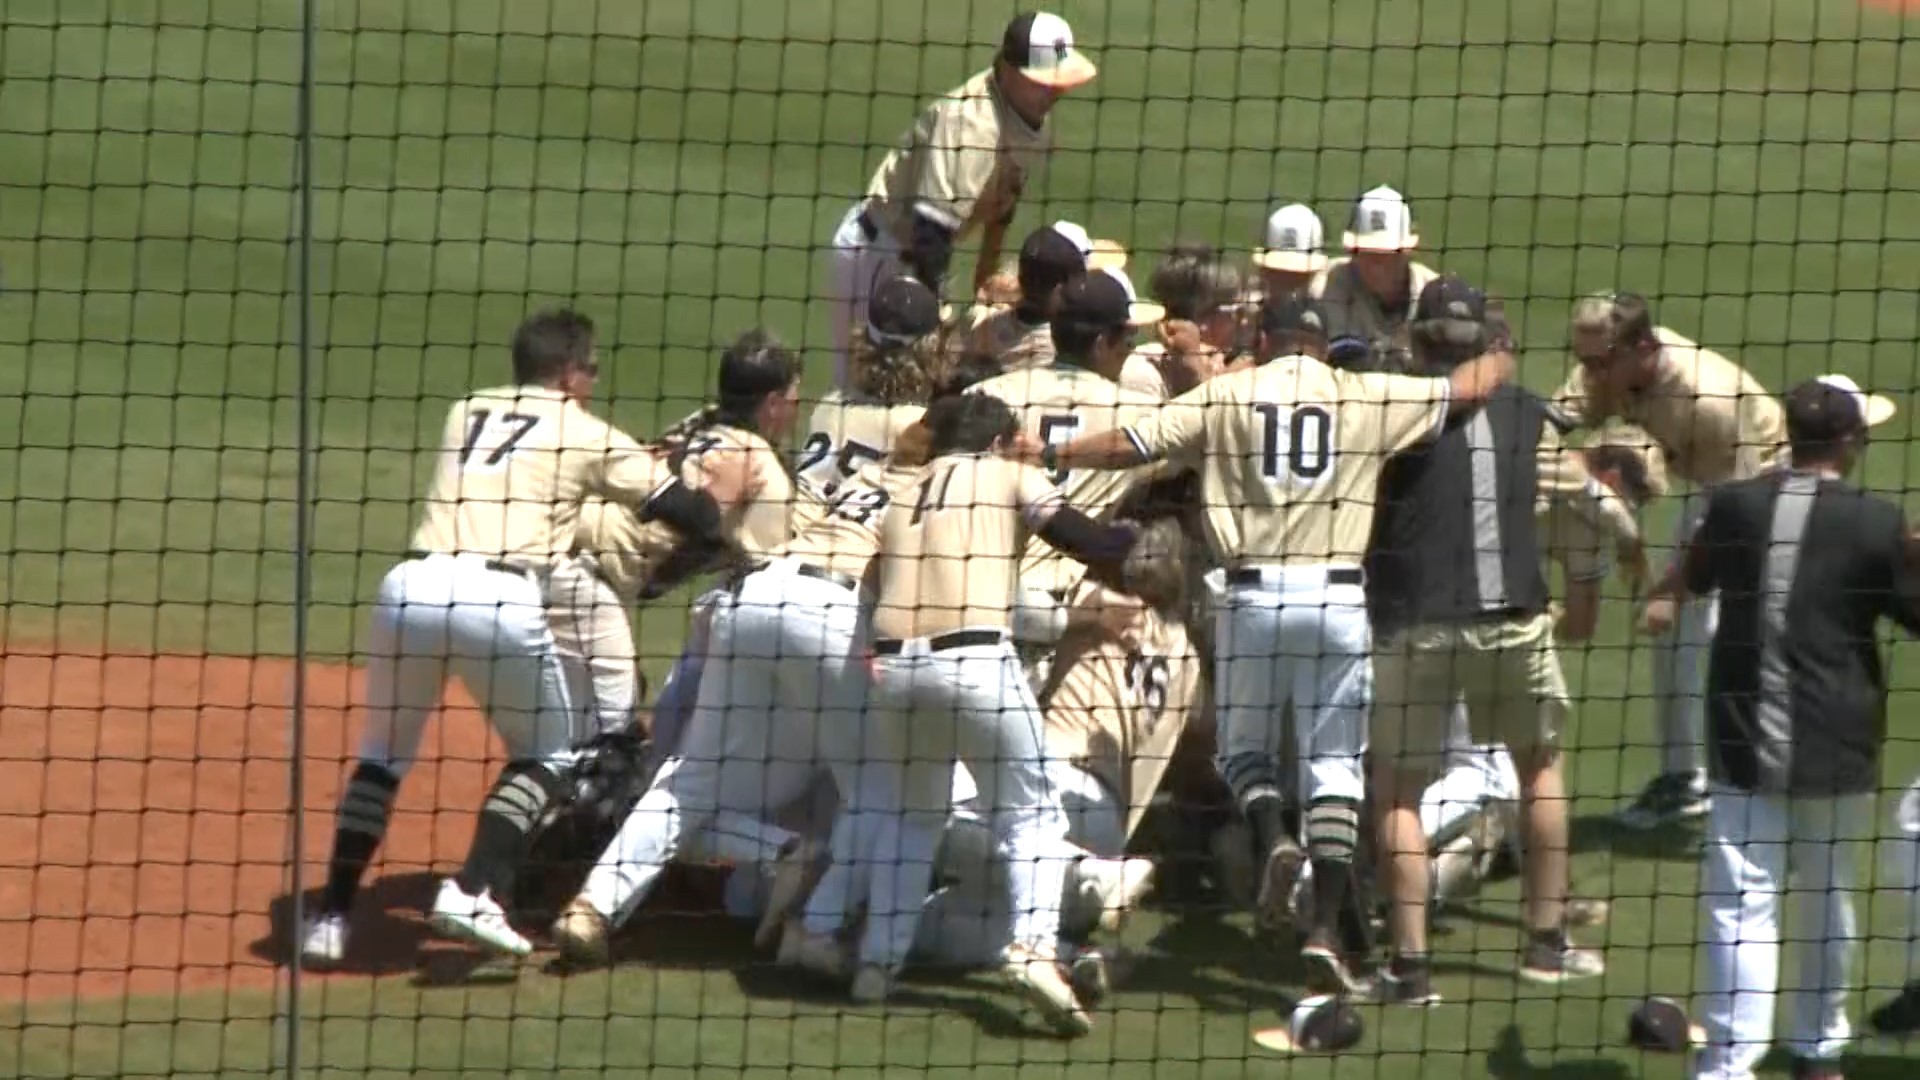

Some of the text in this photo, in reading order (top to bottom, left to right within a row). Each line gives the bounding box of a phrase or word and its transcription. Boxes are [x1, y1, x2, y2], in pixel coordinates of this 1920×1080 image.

[457, 409, 540, 466] 17
[1256, 402, 1330, 477] 10
[909, 463, 958, 527] 11
